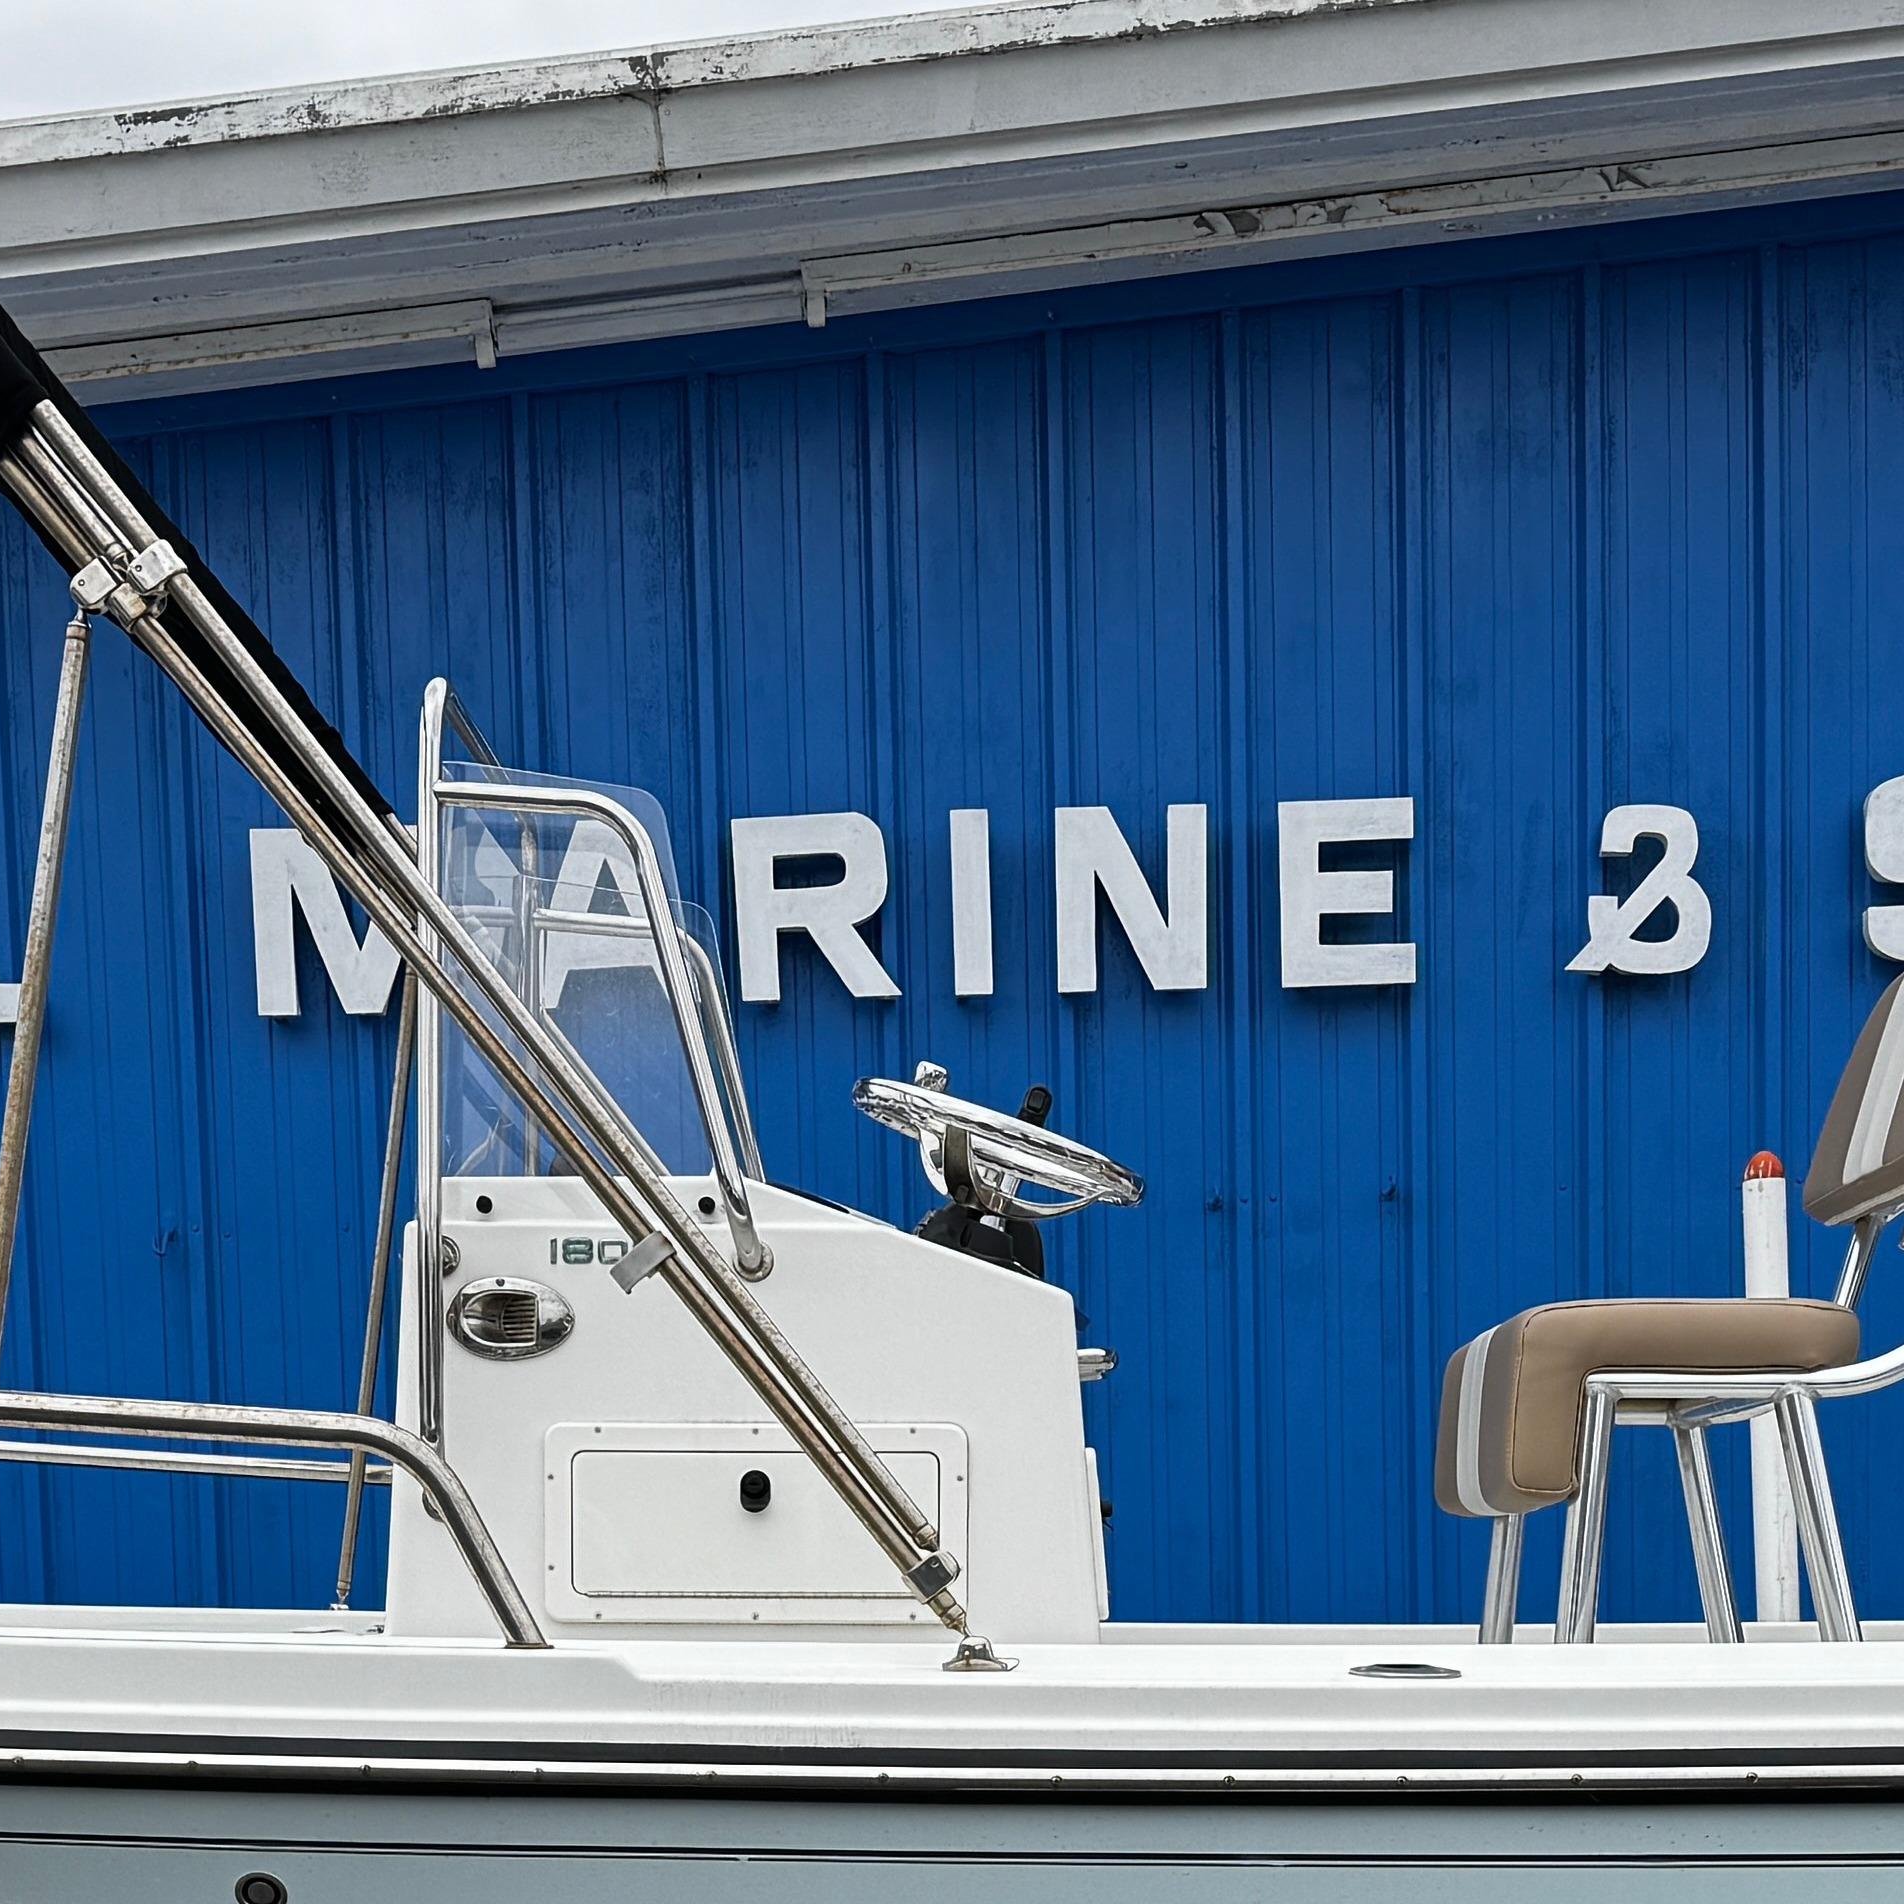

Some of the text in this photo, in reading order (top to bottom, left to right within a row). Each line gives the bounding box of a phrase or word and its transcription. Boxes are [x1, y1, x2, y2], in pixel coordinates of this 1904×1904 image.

[248, 796, 1416, 1020] MARINE
[1564, 804, 1713, 978] &
[549, 1236, 629, 1266] 180
